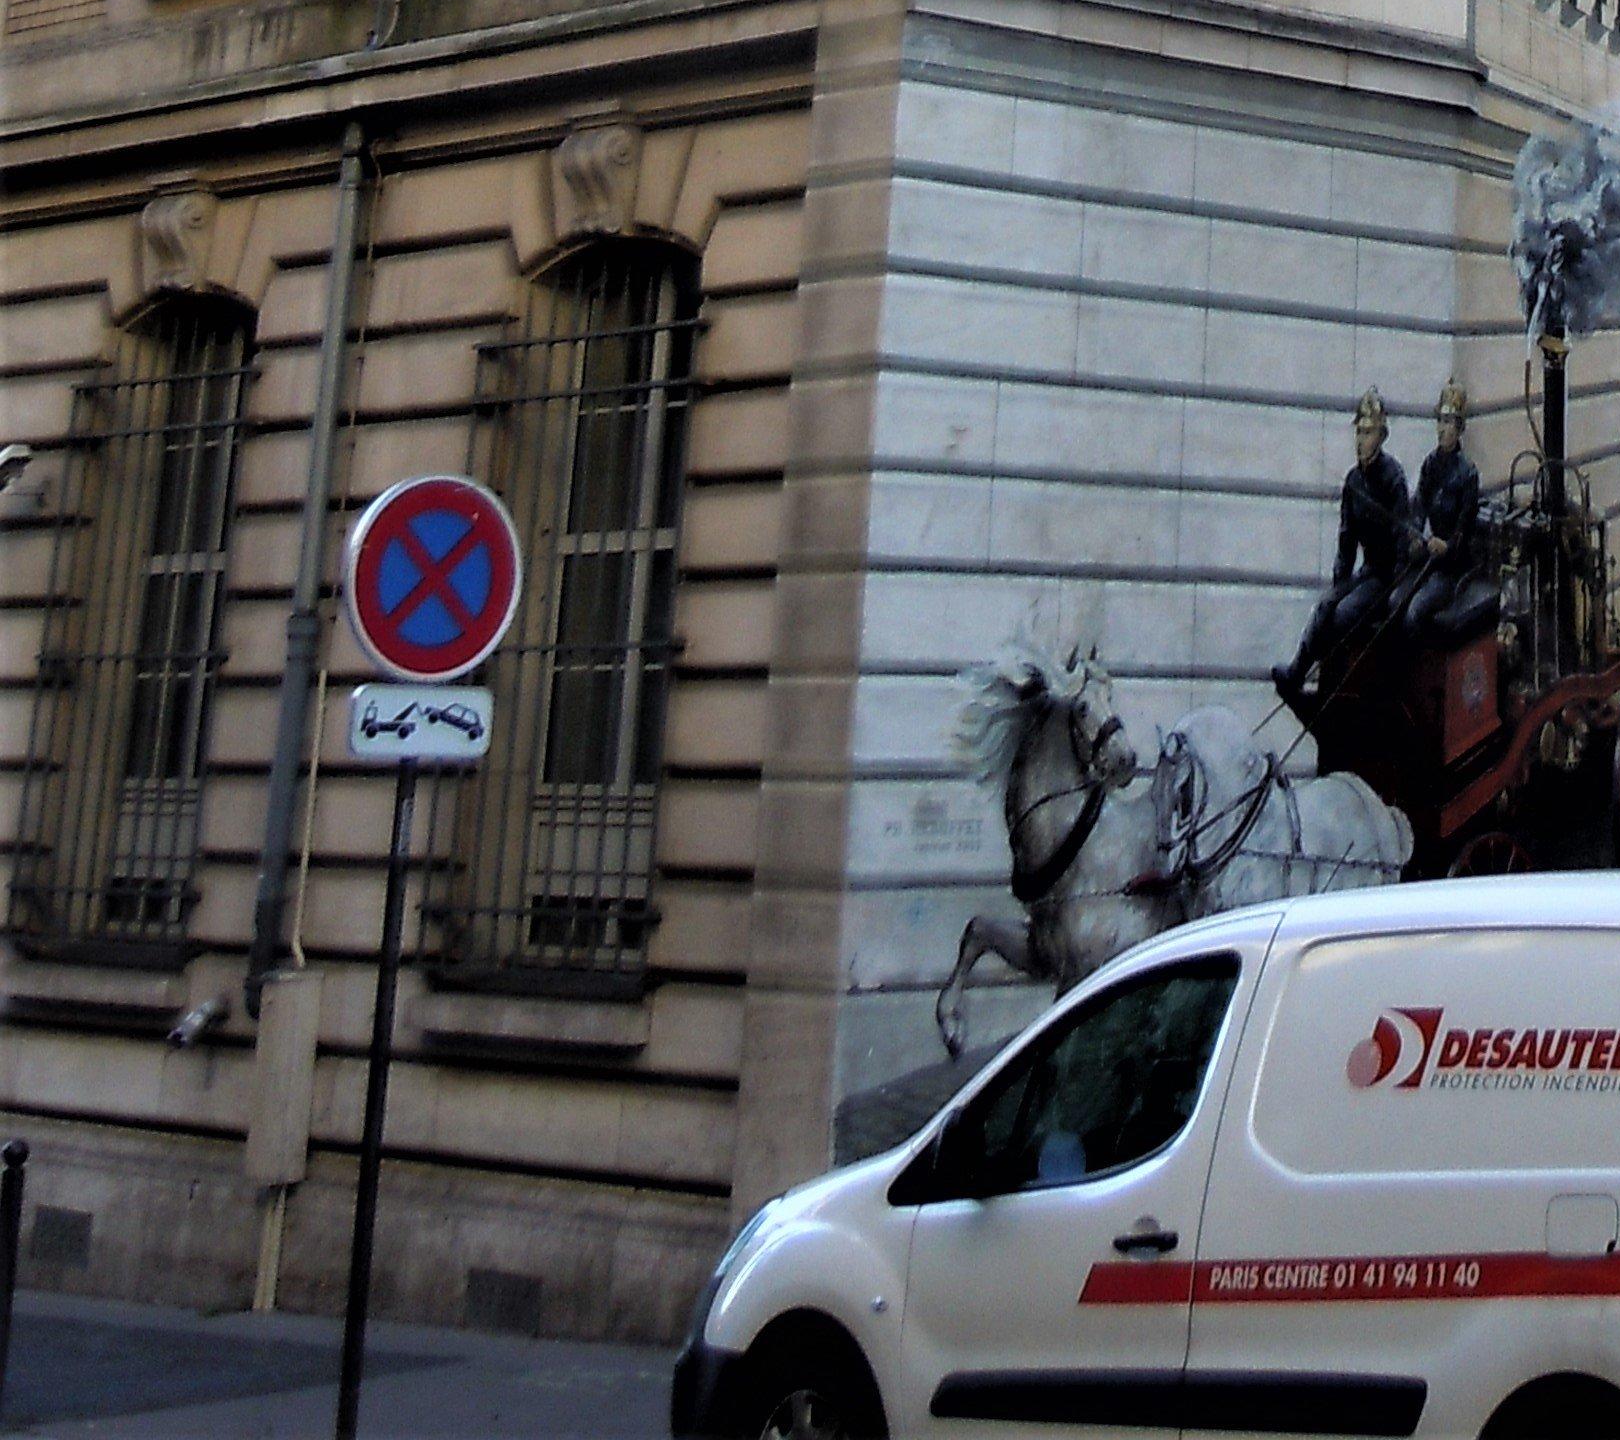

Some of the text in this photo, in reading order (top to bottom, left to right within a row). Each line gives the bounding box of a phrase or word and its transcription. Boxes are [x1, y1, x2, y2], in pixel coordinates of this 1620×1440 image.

[1430, 1073, 1535, 1091] PROTECTION
[1209, 1261, 1480, 1290] PARIS CENTRE 01 41 94 11 40
